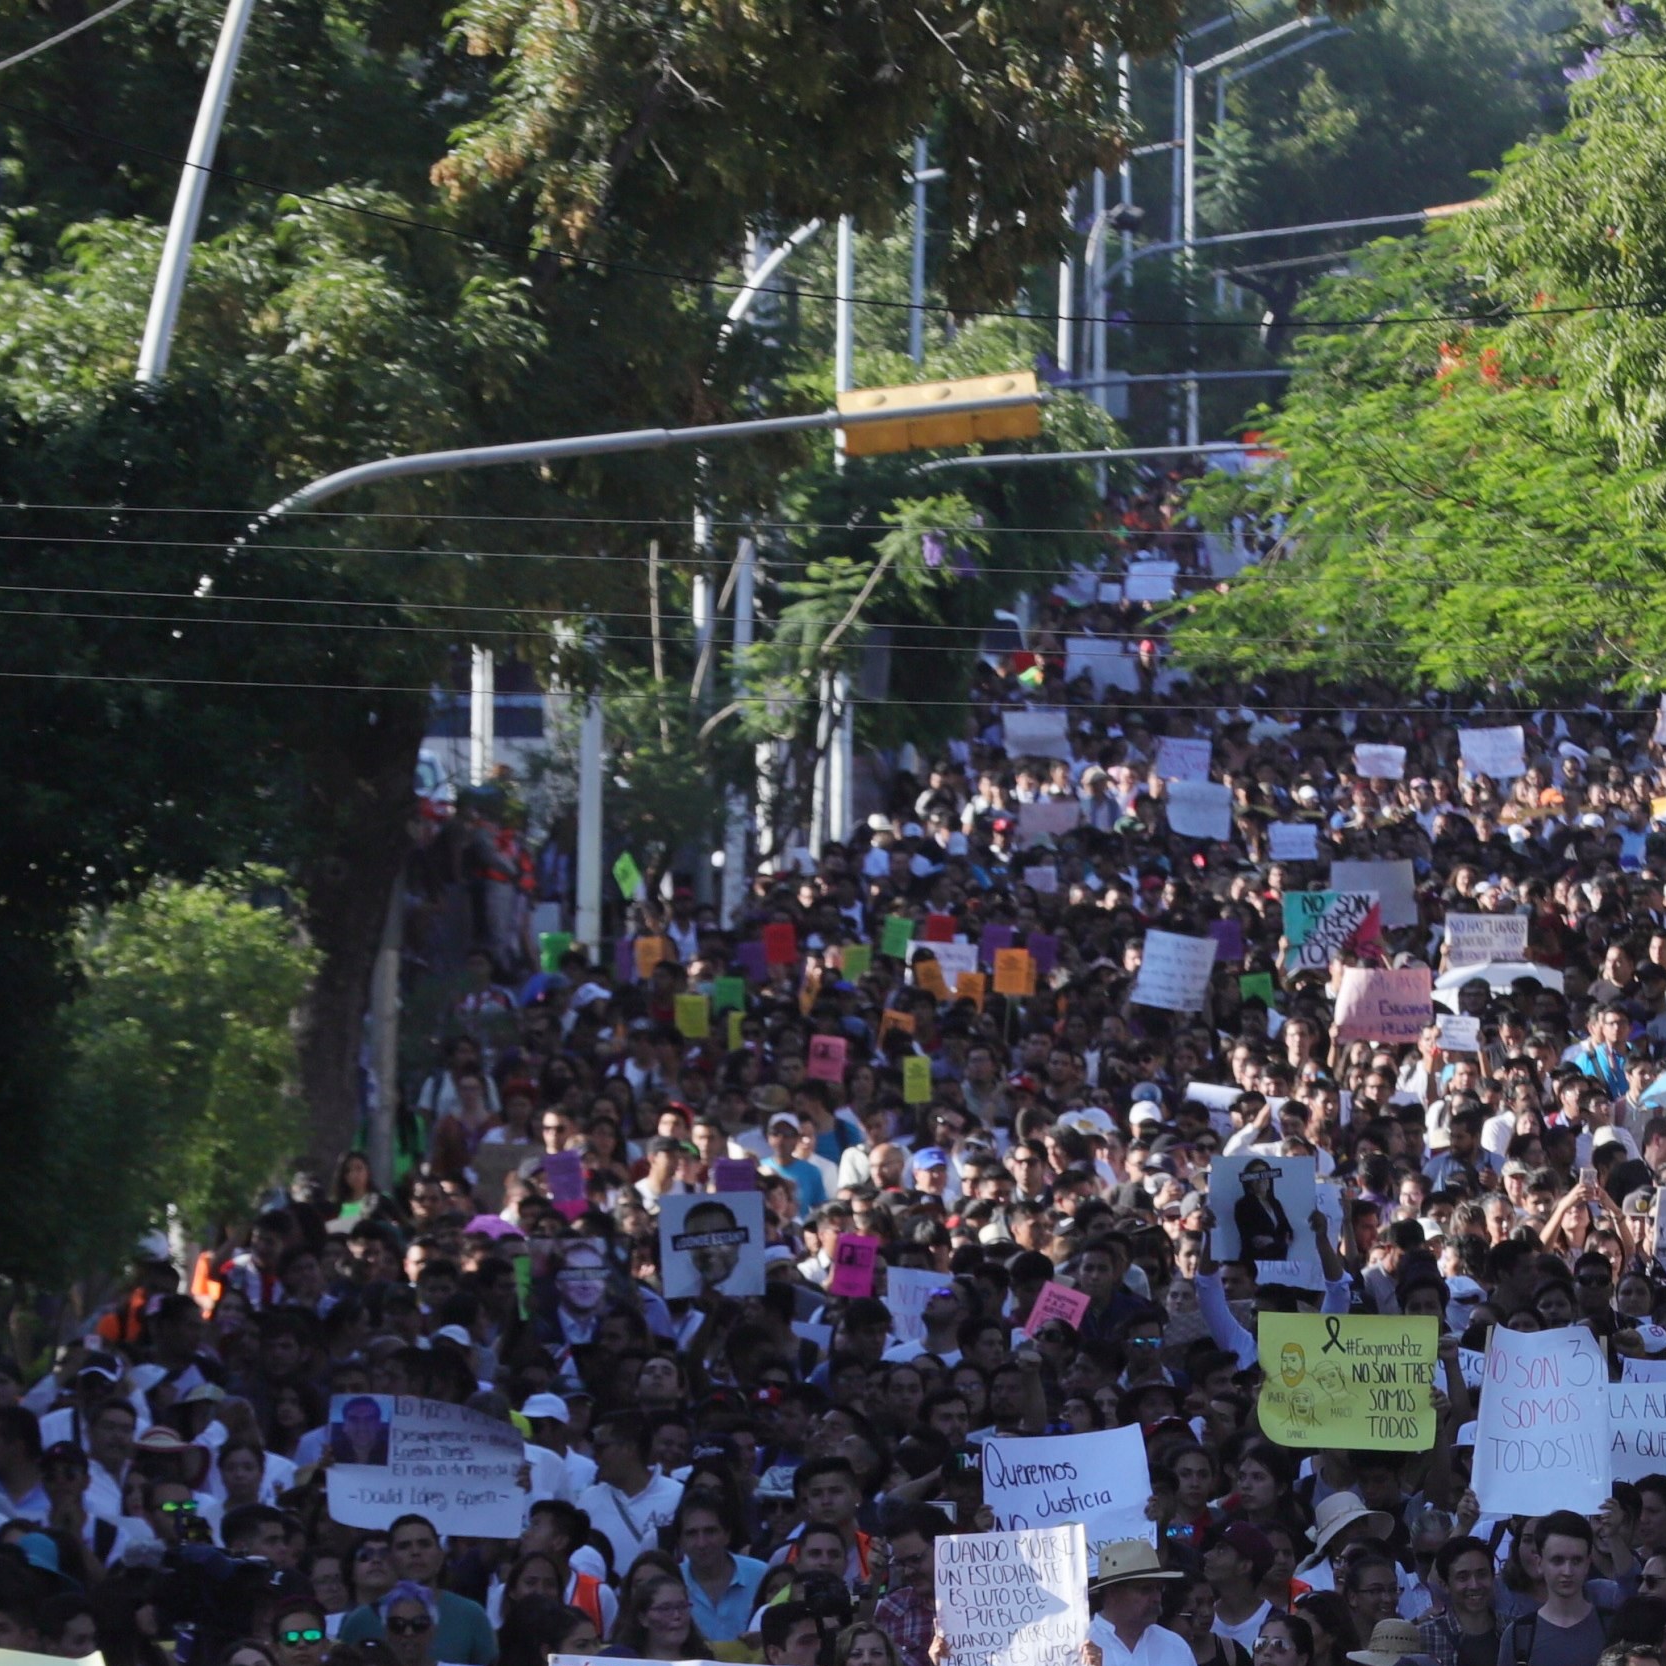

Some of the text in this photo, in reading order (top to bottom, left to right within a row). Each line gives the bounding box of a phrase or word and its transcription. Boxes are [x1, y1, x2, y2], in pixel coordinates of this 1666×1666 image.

[1352, 1362, 1434, 1384] NO SON TRES
[1487, 1346, 1560, 1389] NO SON
[1369, 1389, 1416, 1412] SOMOS
[1501, 1392, 1581, 1430] SOMOS
[1609, 1392, 1637, 1420] LA
[1365, 1416, 1418, 1439] TODOS
[1612, 1430, 1627, 1454] A
[985, 1442, 1078, 1491] Queremos
[1037, 1487, 1112, 1518] Justicia
[939, 1539, 1009, 1565] CUANDO
[1015, 1532, 1075, 1560] MUERE
[950, 1584, 1048, 1607] ES LUTO DEL
[1008, 1620, 1078, 1645] MUERE UN
[1010, 1644, 1073, 1664] ES LUTO
